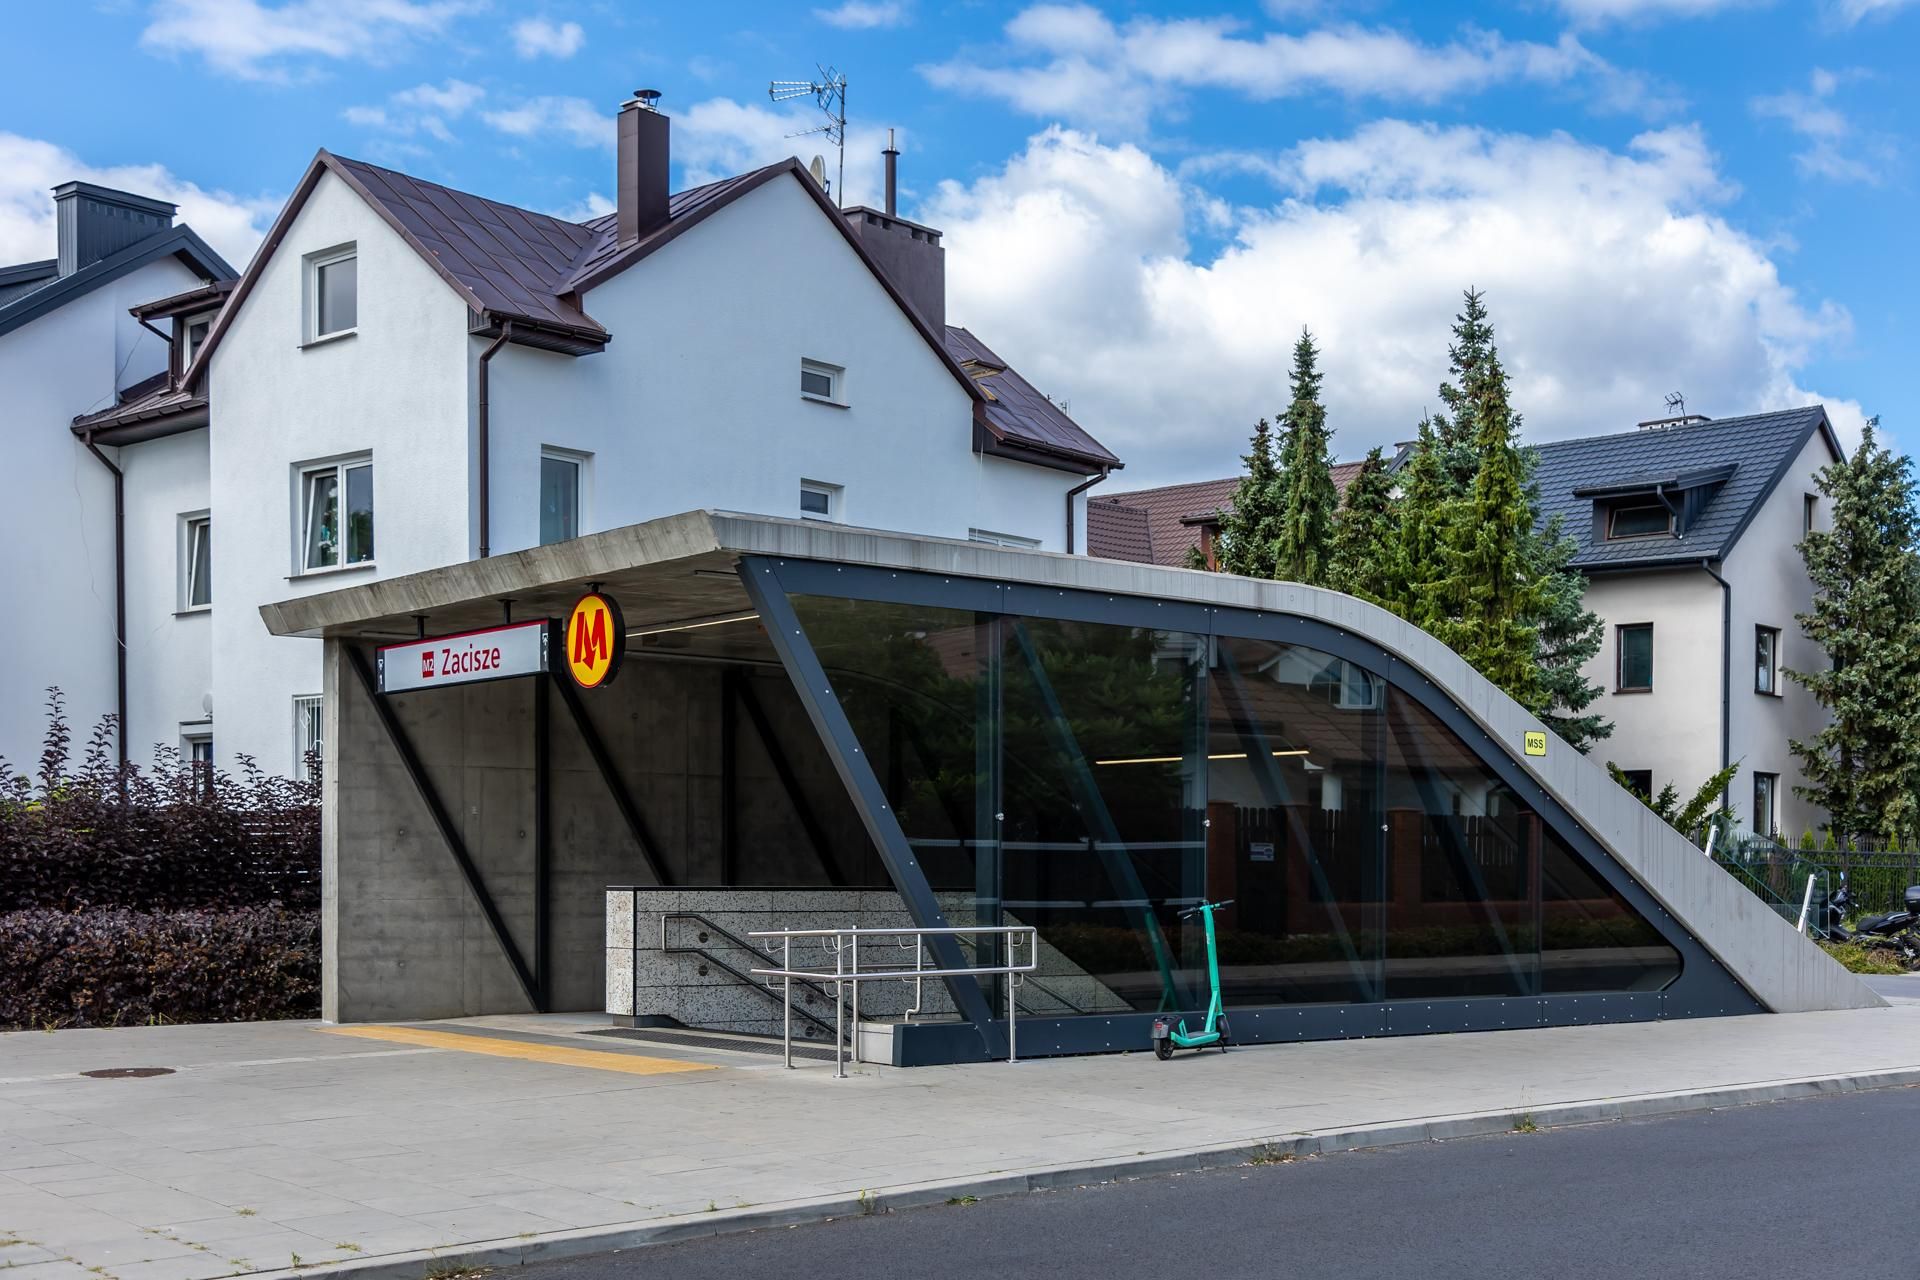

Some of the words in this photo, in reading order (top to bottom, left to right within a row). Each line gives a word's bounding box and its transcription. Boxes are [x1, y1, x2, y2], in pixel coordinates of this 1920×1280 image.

[574, 608, 608, 671] M
[422, 659, 434, 672] M2
[441, 643, 501, 675] Zacisze
[543, 650, 547, 662] 1
[1527, 738, 1544, 749] MSS
